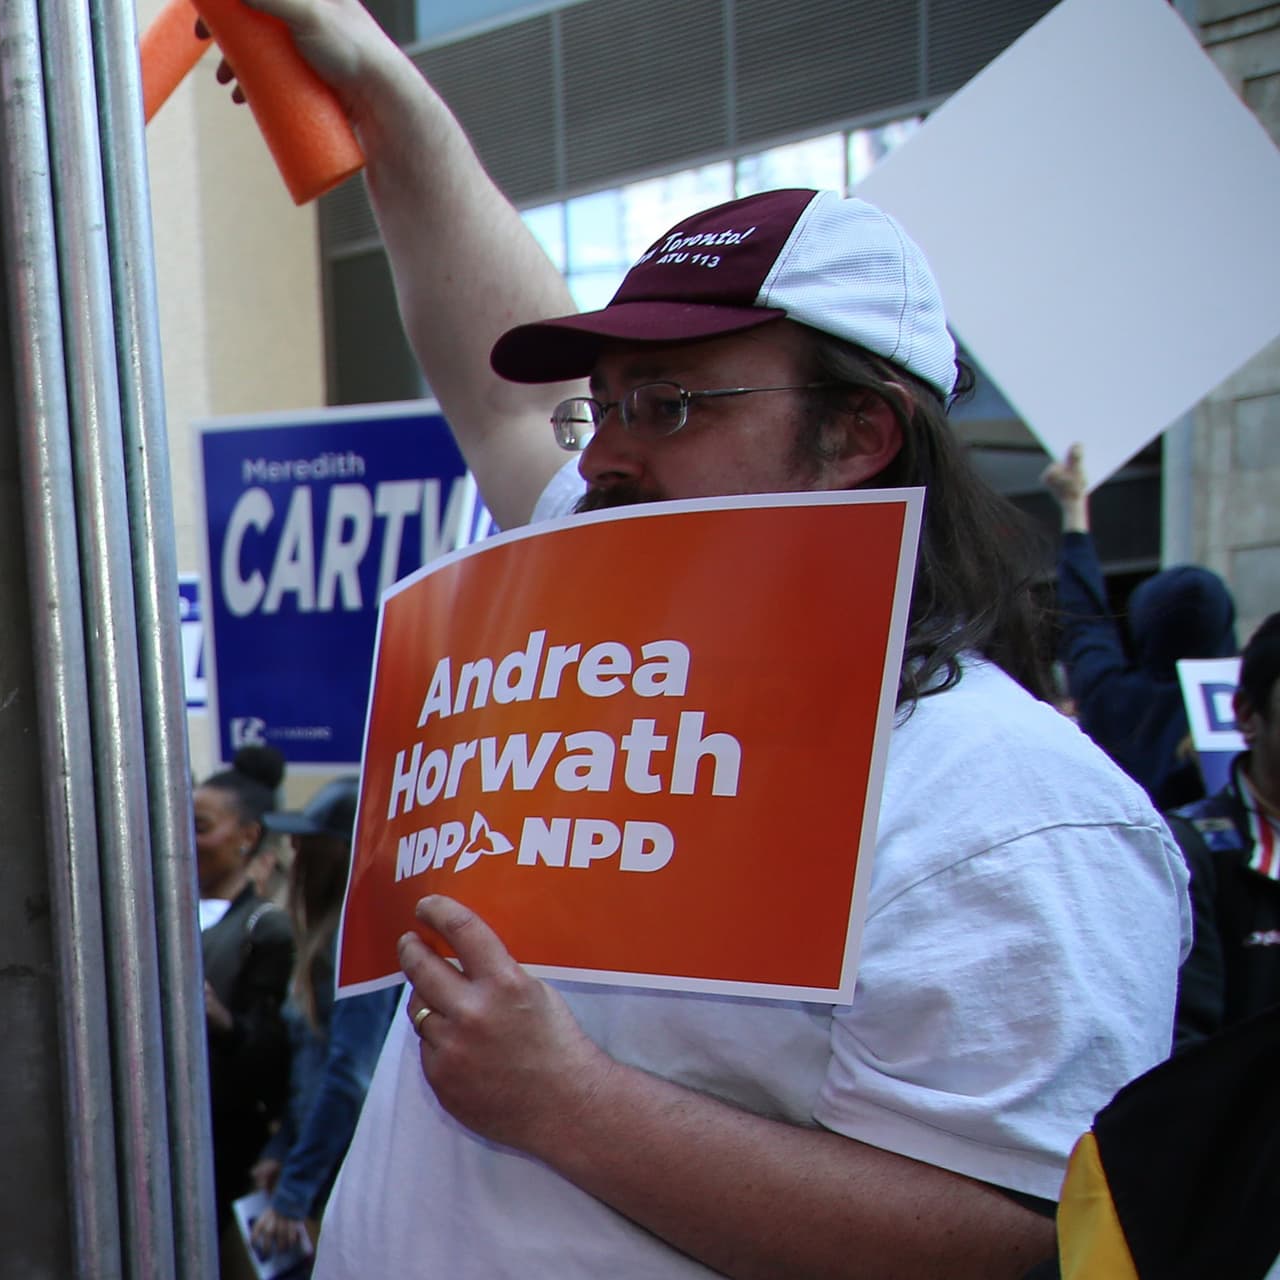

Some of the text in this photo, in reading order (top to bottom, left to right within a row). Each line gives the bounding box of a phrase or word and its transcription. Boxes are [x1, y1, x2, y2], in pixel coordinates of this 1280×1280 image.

[656, 253, 690, 265] ATU
[691, 254, 721, 268] 113
[243, 452, 366, 483] Meredith
[416, 630, 691, 729] Andrea
[386, 711, 742, 820] Horwath
[394, 816, 675, 882] NDP NPD
